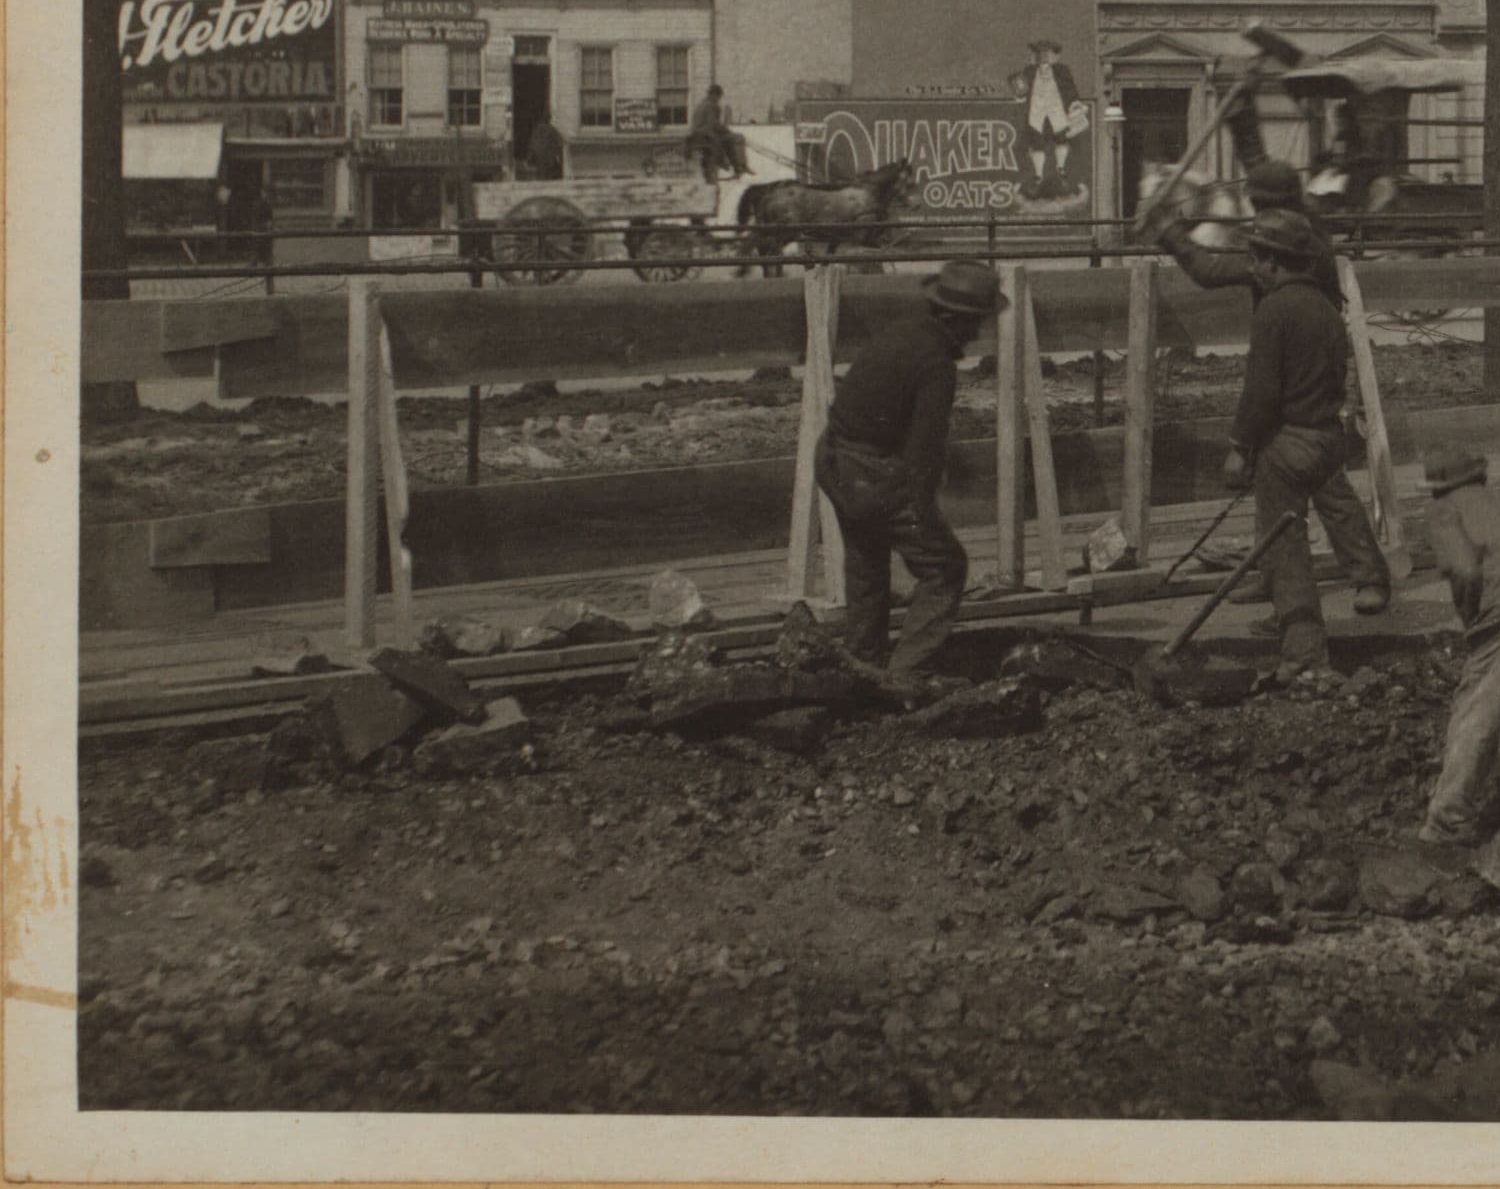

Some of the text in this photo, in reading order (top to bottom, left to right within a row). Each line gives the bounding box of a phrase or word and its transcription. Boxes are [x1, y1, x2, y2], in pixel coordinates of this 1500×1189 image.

[167, 60, 328, 97] CASTORIA
[807, 111, 1018, 184] QUAKER
[923, 180, 1013, 208] OATS
